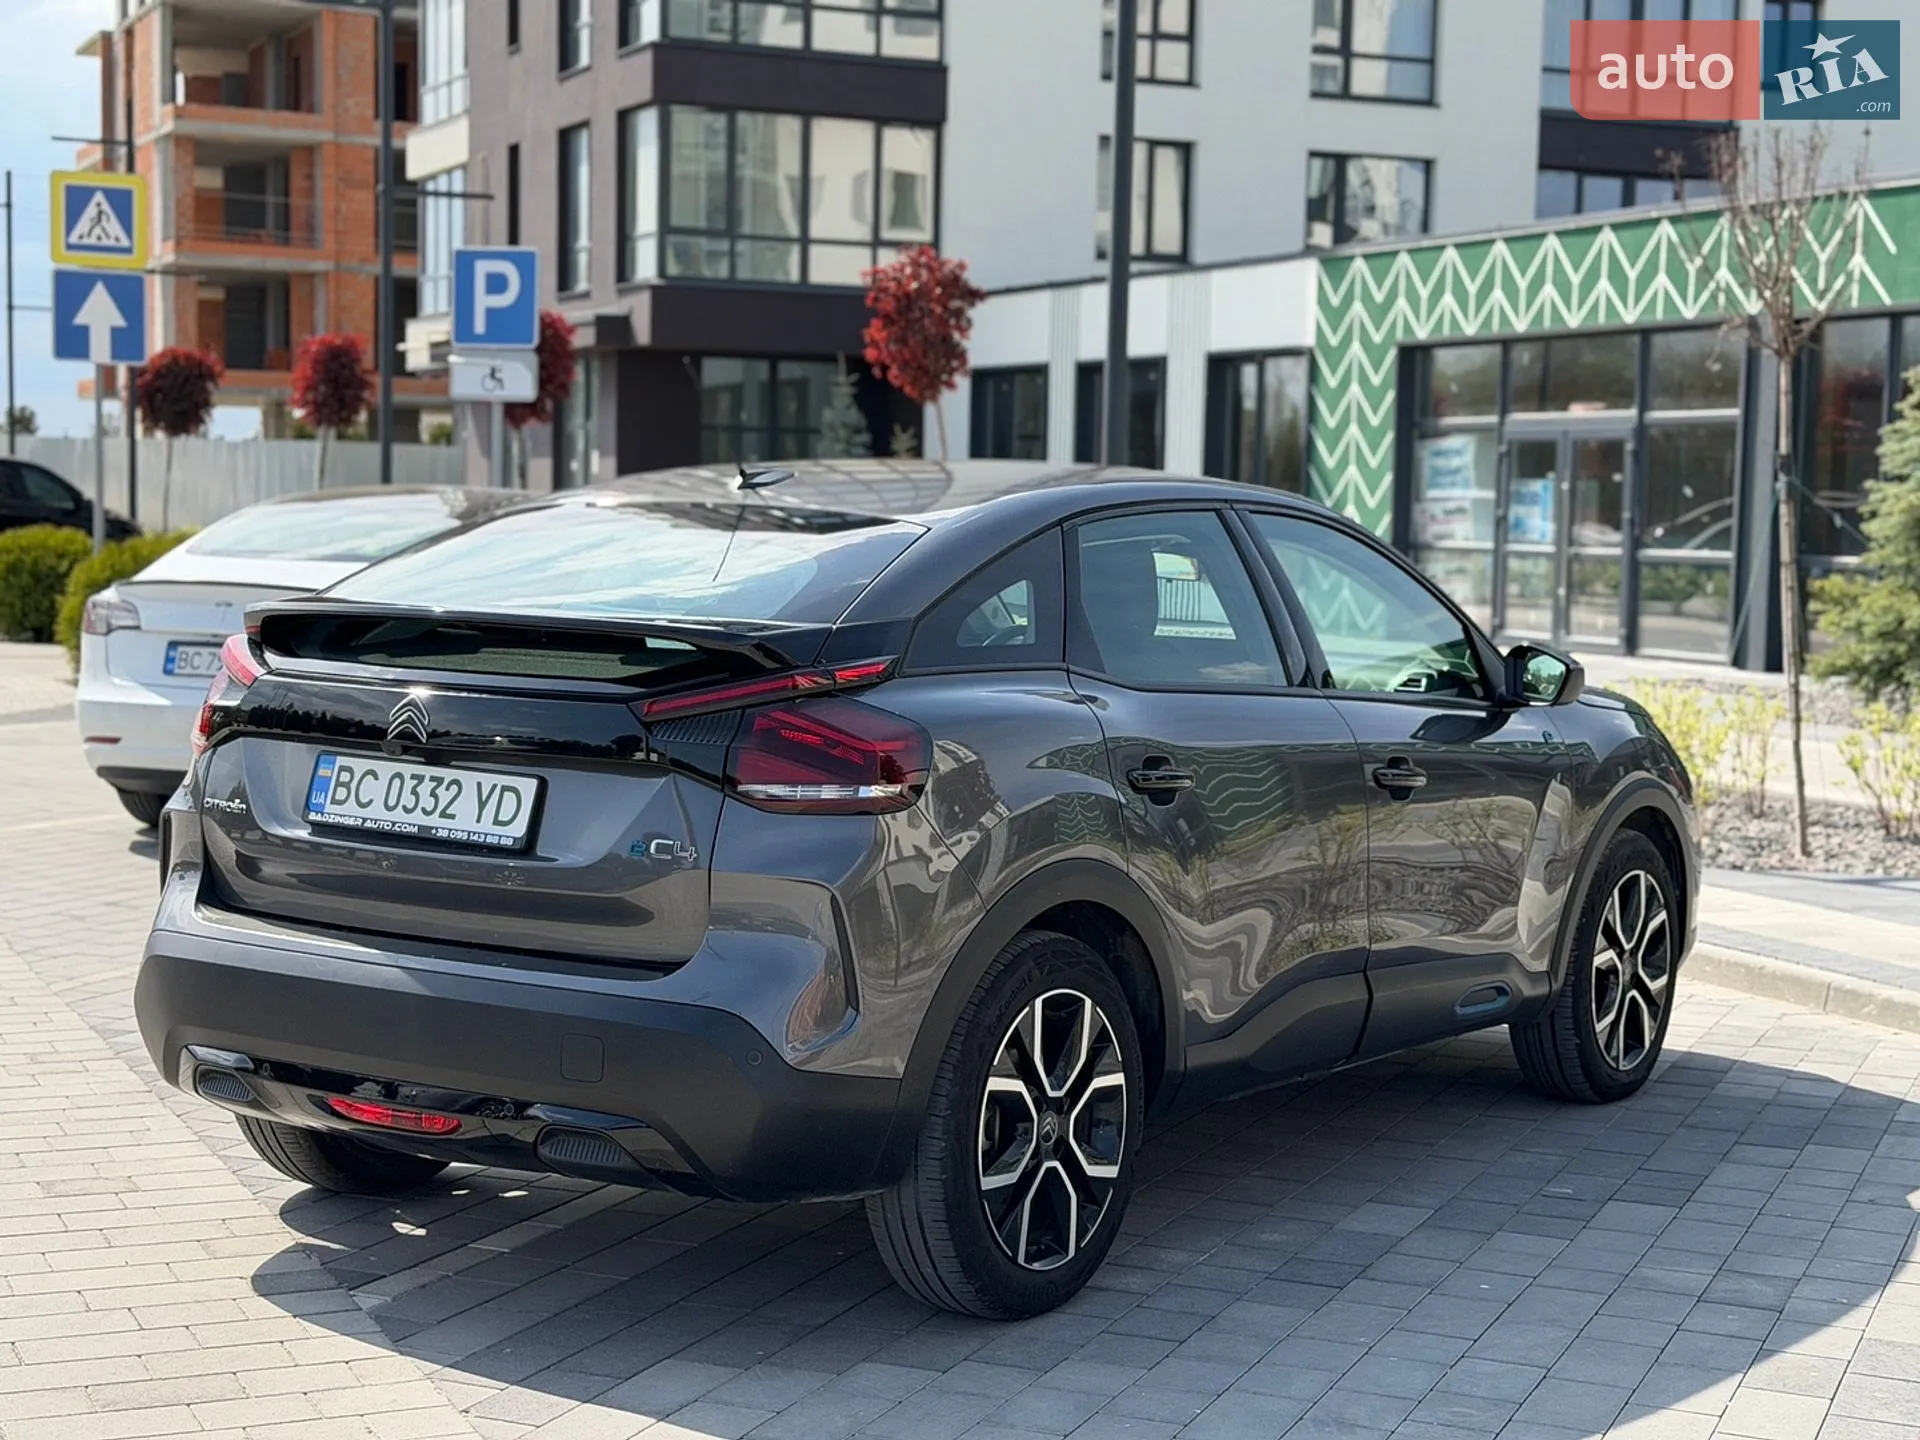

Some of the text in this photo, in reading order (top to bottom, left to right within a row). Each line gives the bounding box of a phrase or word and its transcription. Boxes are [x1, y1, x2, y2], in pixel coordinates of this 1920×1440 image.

[473, 259, 521, 335] P
[311, 791, 326, 804] UA
[330, 765, 523, 828] BC 0332 YD
